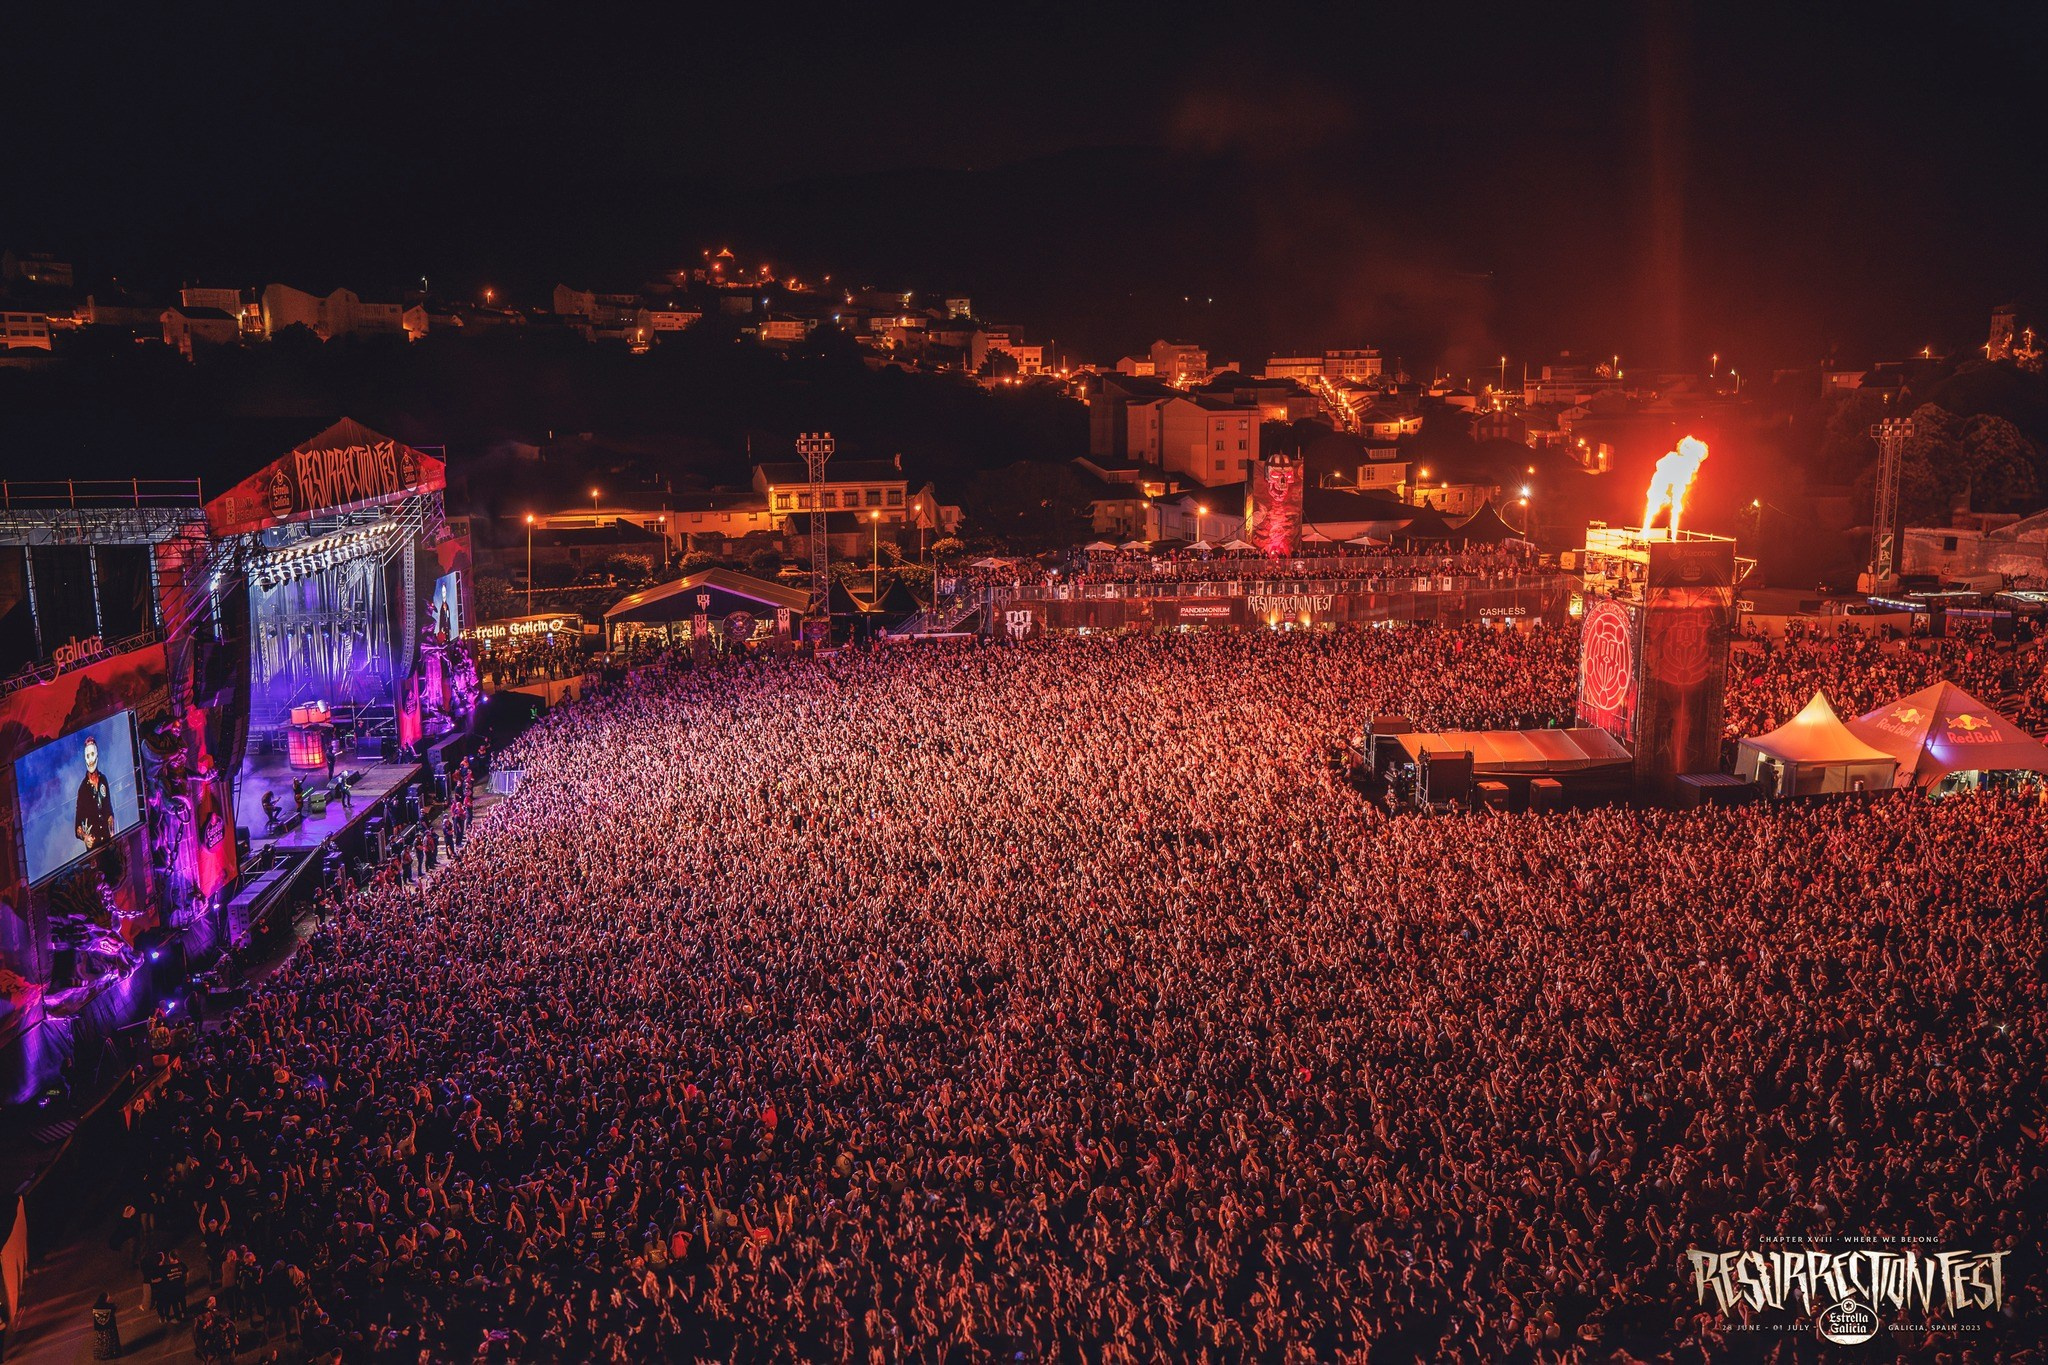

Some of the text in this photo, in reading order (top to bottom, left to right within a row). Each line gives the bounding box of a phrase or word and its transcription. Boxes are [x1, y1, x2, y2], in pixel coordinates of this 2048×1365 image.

[293, 440, 400, 519] RESURRECTION FEST
[1247, 595, 1312, 616] RESURRECTION
[1479, 607, 1526, 616] CASHLESS
[509, 621, 549, 635] Galicia
[1876, 718, 1917, 737] Red Bull
[1946, 729, 2003, 744] Red Bull
